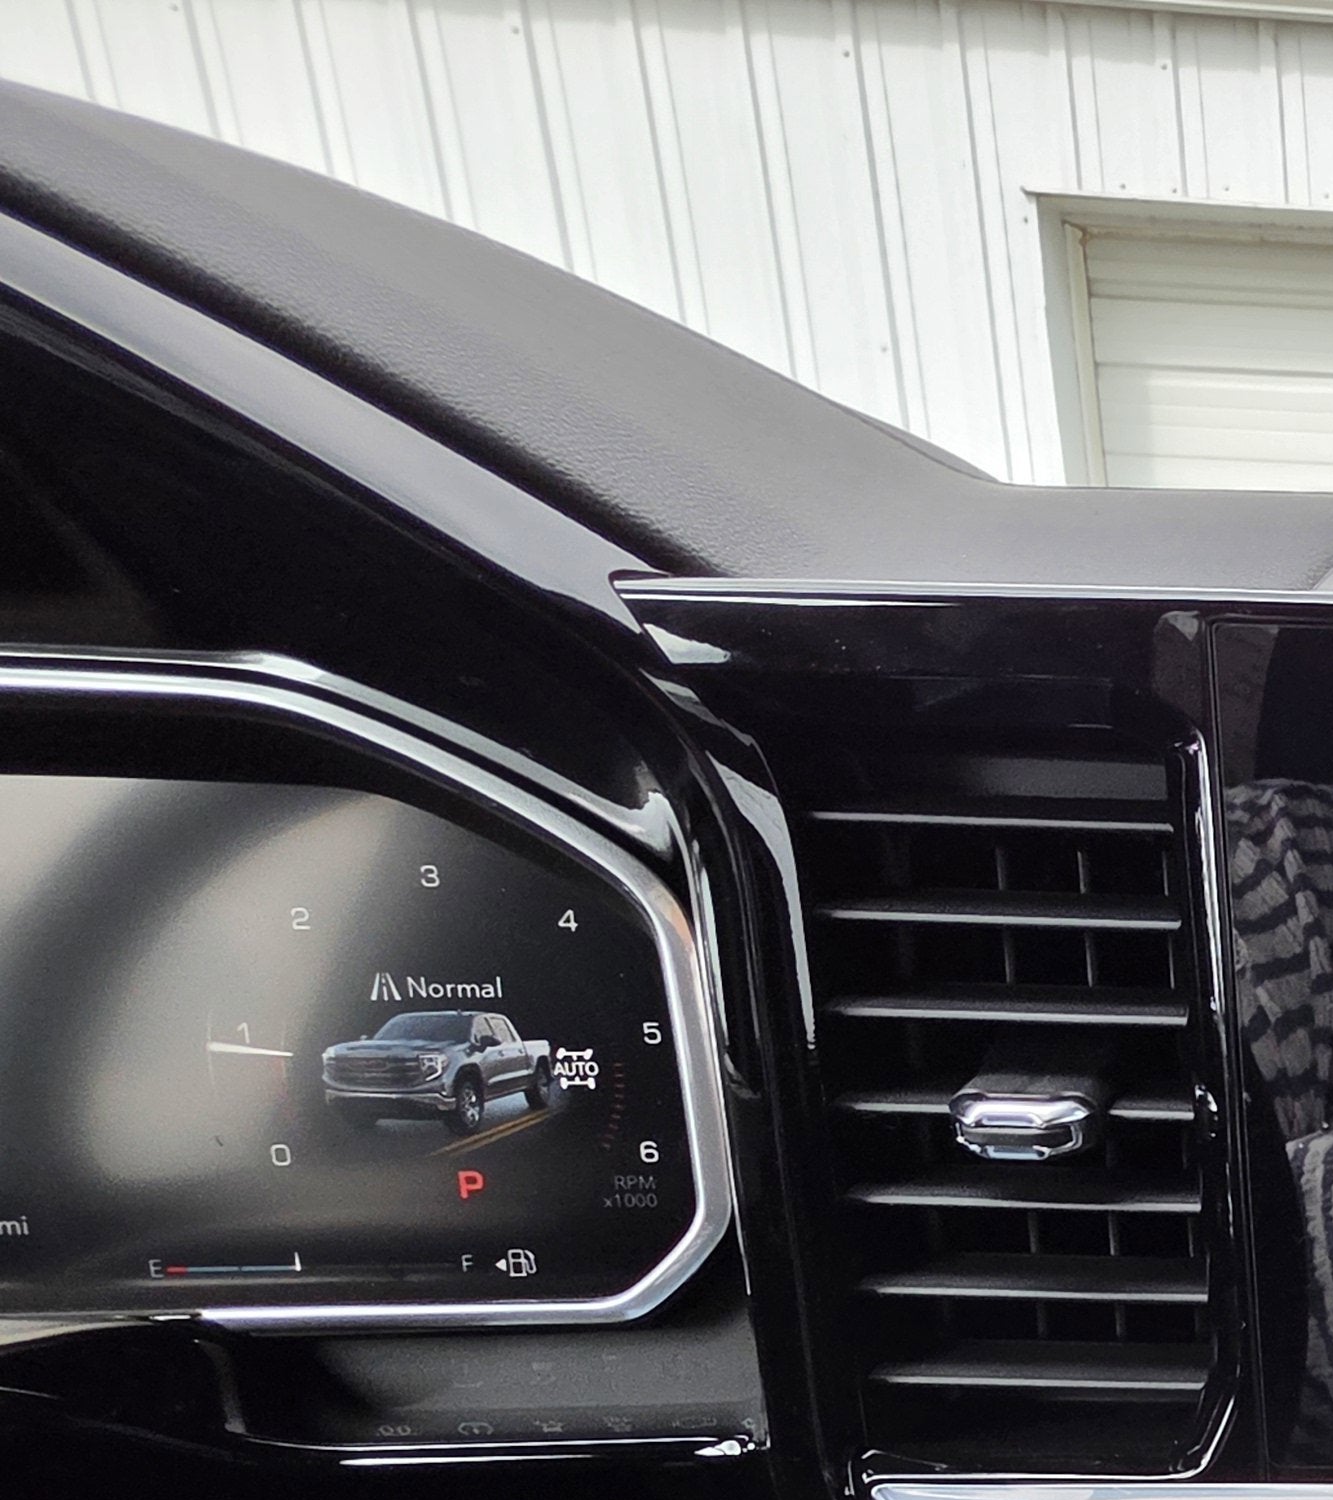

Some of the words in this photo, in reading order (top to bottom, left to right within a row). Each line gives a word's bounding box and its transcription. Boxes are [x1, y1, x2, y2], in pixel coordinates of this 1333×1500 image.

[420, 865, 441, 888] 3
[291, 907, 311, 930] 2
[557, 909, 578, 933] 4
[406, 976, 503, 999] Normal
[236, 1022, 250, 1044] 1
[642, 1022, 661, 1046] 5
[554, 1060, 599, 1079] AUTO
[270, 1144, 291, 1167] 0
[639, 1141, 659, 1163] 6
[457, 1171, 485, 1199] P
[613, 1175, 656, 1191] RPM
[603, 1193, 658, 1209] x1000
[149, 1259, 163, 1278] E
[461, 1255, 473, 1273] F
